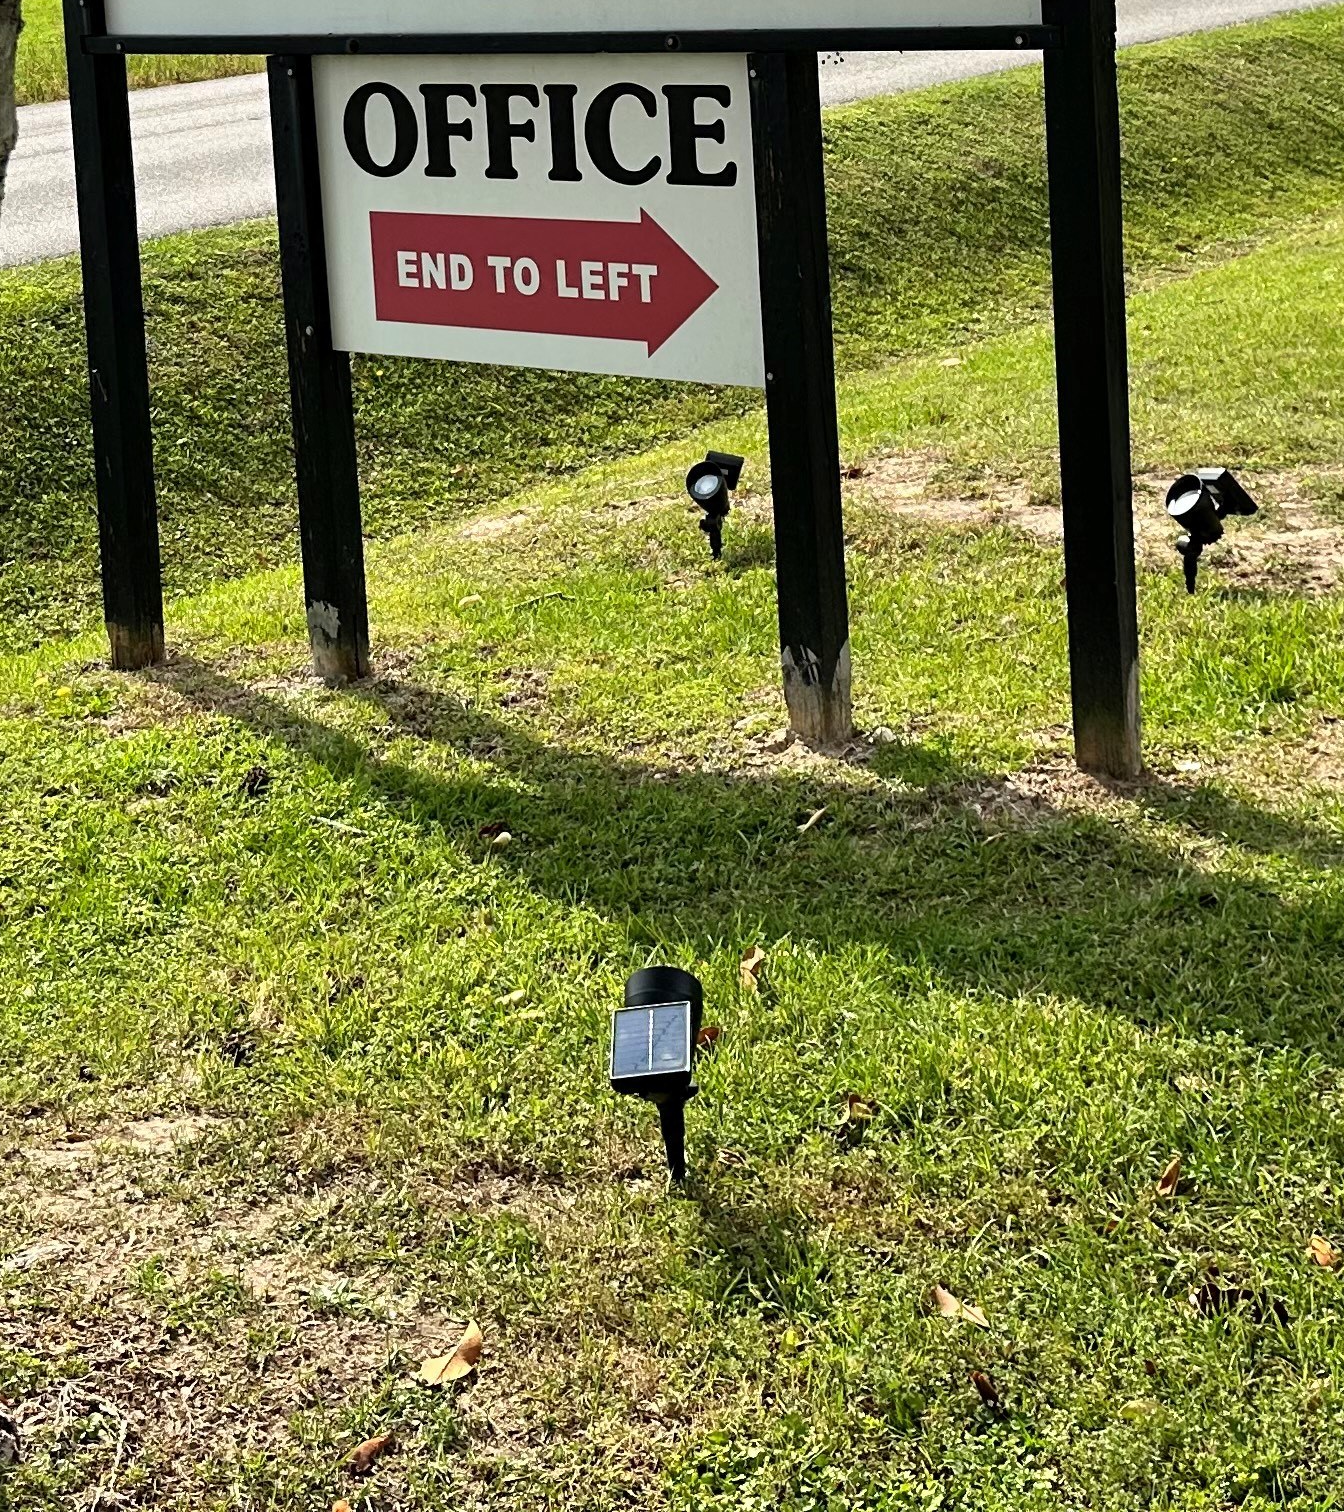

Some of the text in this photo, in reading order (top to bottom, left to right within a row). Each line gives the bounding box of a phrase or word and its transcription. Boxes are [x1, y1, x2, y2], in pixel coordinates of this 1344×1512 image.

[342, 81, 738, 187] OFFICE
[396, 250, 658, 304] END TO LEFT
